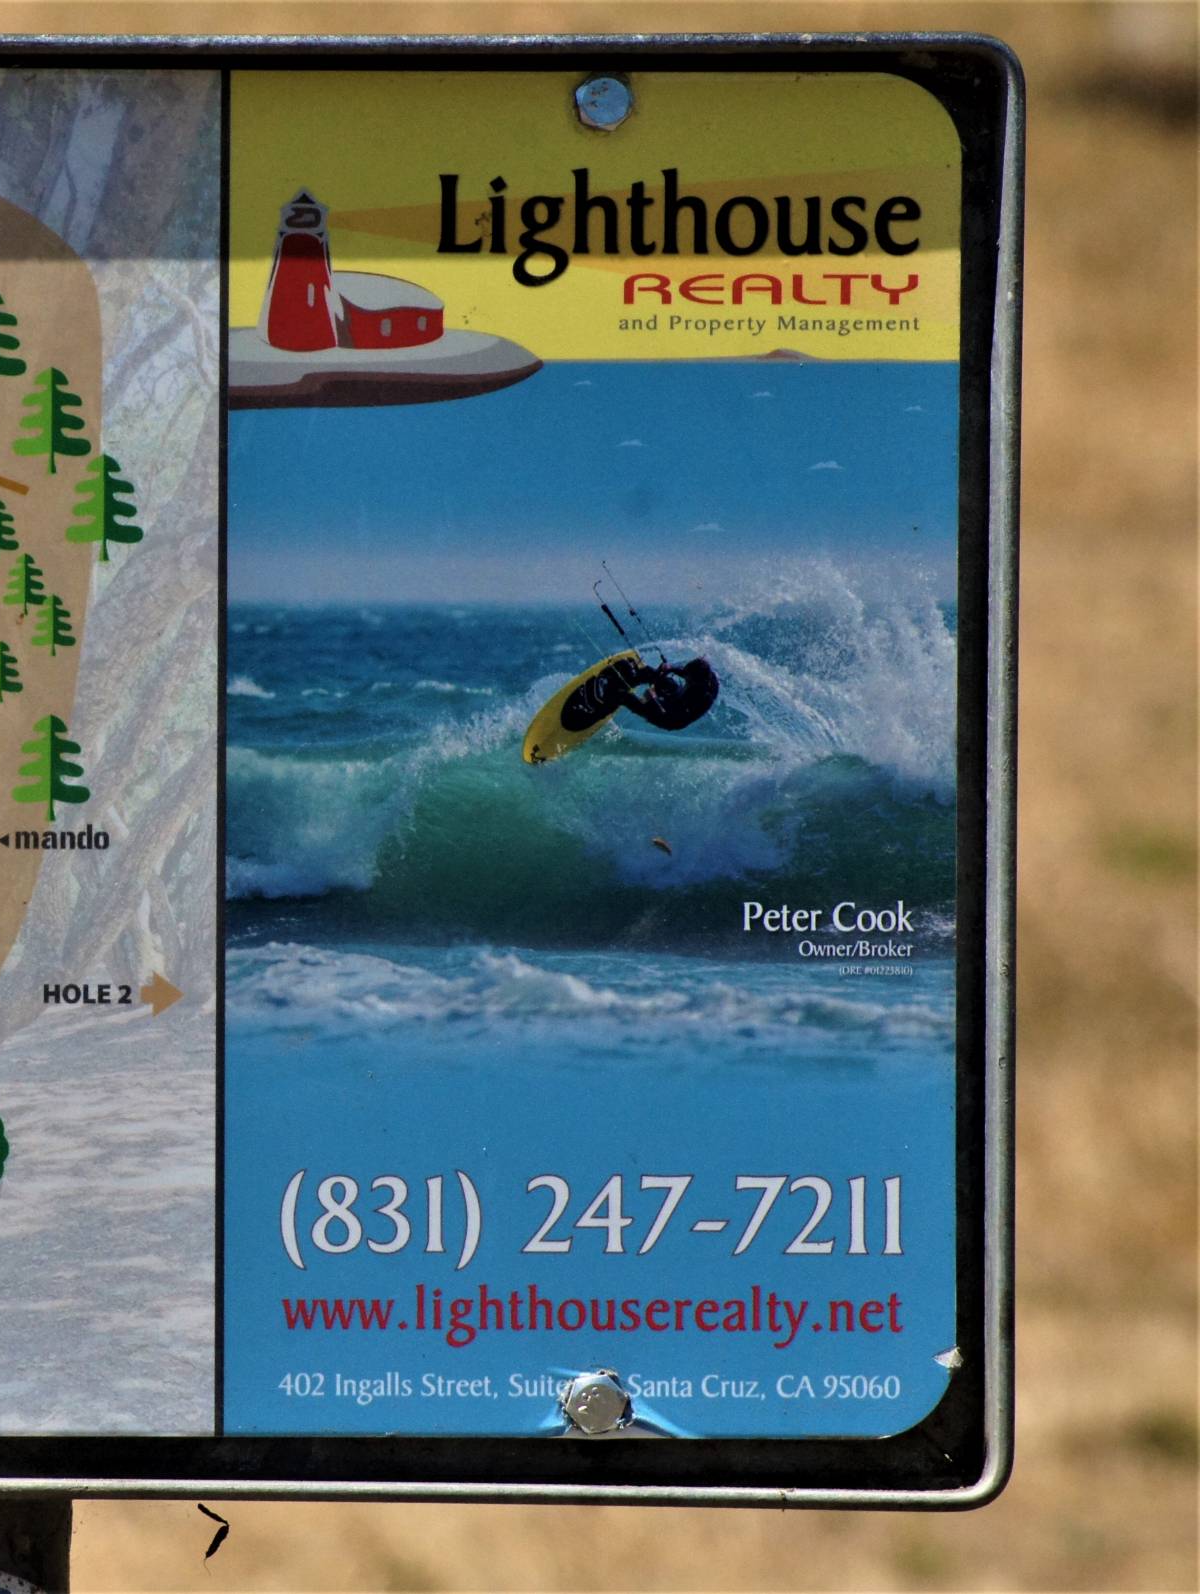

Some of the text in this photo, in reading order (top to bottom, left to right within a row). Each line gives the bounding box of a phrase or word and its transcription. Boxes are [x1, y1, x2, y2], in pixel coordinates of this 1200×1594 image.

[437, 167, 921, 288] Lighthouse
[624, 274, 918, 305] REALTY
[619, 315, 919, 336] and Property Management
[15, 824, 109, 849] mando
[743, 900, 914, 932] Peter Cook
[798, 939, 914, 958] Owner/Broker
[44, 984, 132, 1004] HOLE 2
[282, 1172, 903, 1269] (831) 247-7211
[282, 1284, 903, 1349] www.lighthouserealty.net
[278, 1373, 324, 1396] 402
[336, 1372, 412, 1405] Ingalls
[421, 1374, 497, 1399] Street,
[627, 1373, 900, 1400] Santa Cruz, CA 95060
